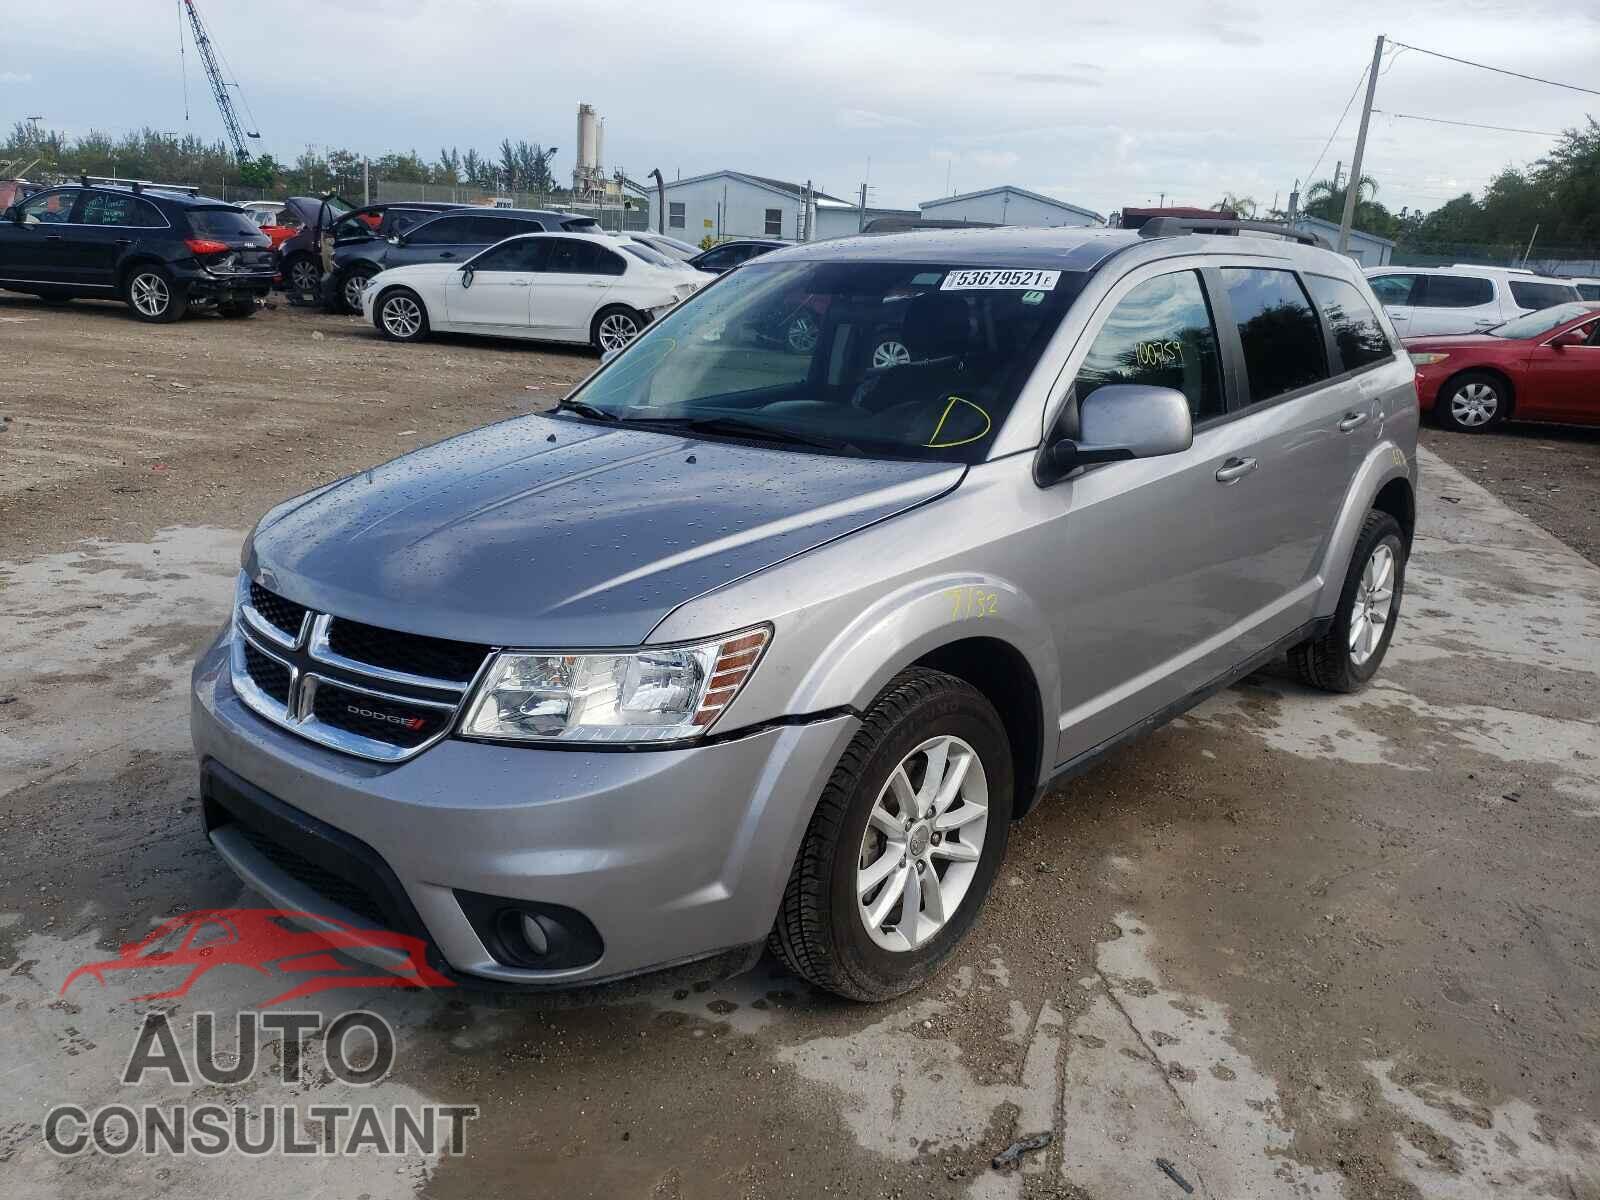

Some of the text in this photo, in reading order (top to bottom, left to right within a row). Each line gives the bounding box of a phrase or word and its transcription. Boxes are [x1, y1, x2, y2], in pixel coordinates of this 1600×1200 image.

[957, 271, 1043, 286] 53679521
[921, 396, 991, 448] D
[347, 705, 416, 727] DODGE
